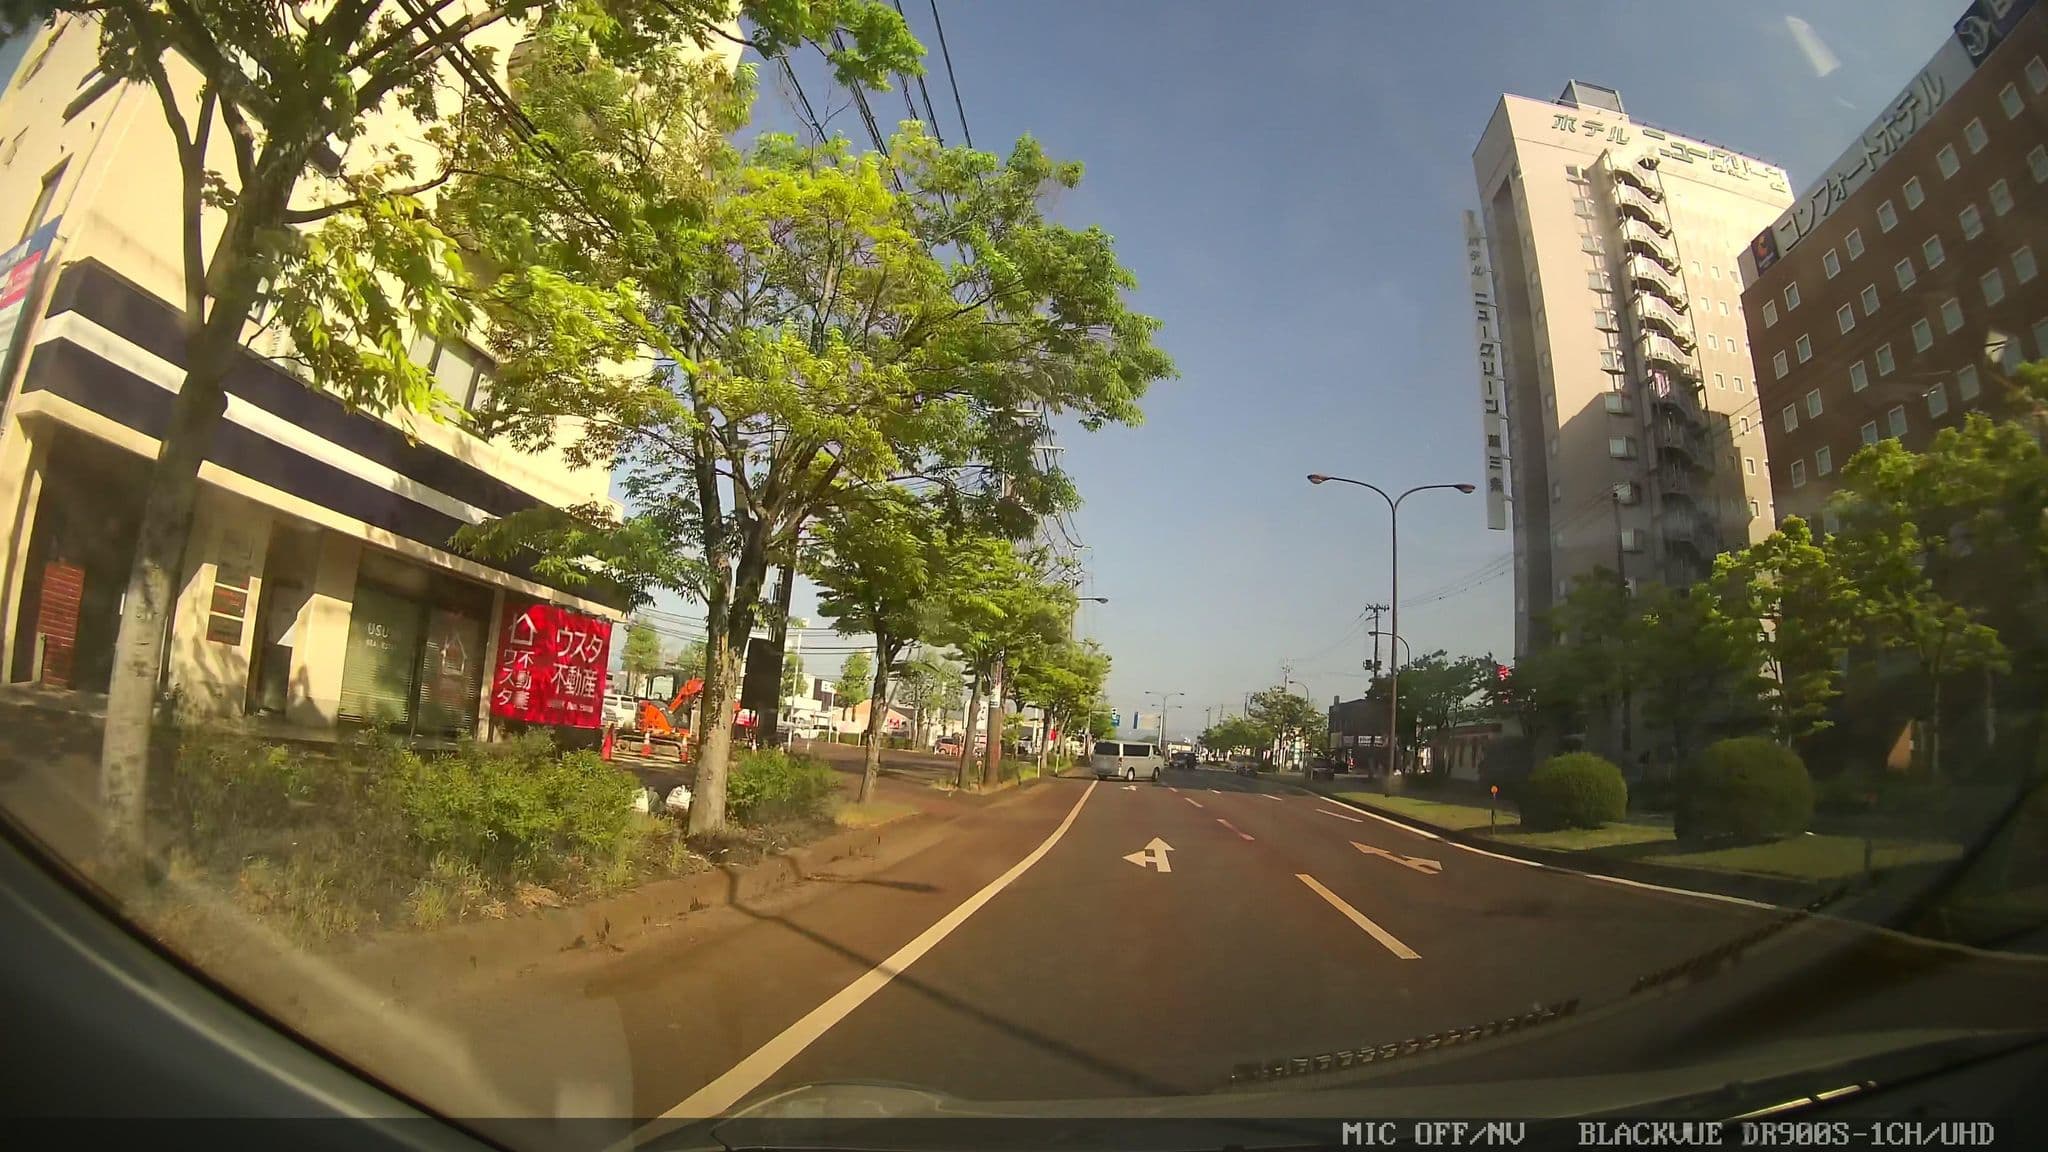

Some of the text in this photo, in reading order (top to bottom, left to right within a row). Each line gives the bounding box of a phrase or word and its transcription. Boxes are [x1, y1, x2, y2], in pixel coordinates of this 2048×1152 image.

[1551, 113, 1631, 146] ホテル
[1779, 70, 1945, 252] コンフォートホテル
[556, 625, 604, 664] ウスタ
[550, 662, 598, 698] 不動産
